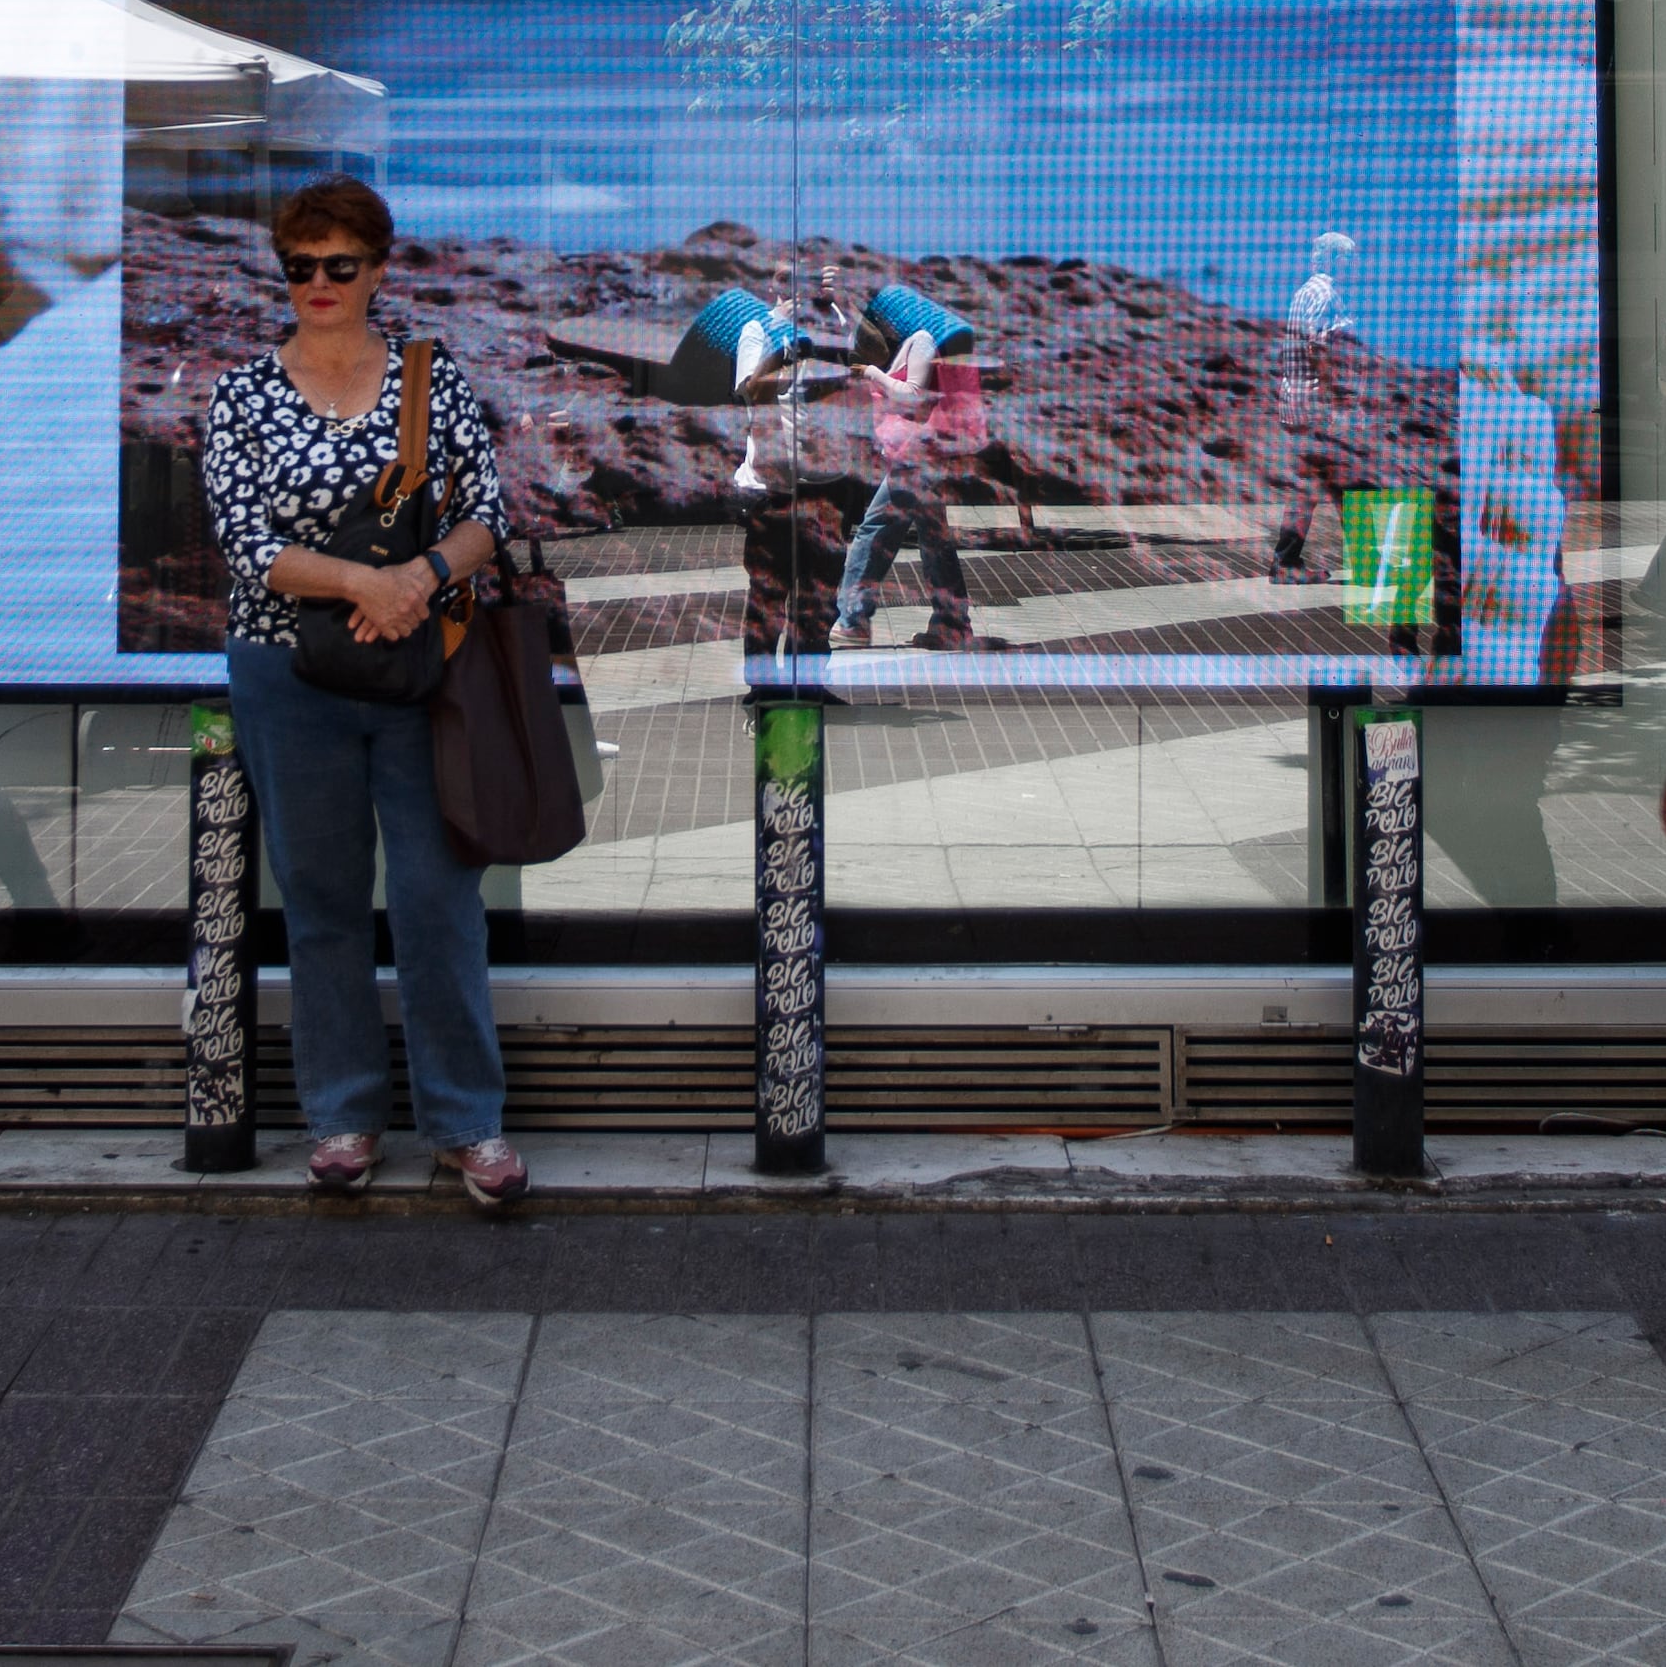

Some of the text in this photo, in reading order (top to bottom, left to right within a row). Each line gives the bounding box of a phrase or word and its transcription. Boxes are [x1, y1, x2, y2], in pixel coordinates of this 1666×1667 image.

[196, 792, 249, 824] POLO
[764, 803, 814, 834] POLO
[1365, 803, 1417, 834] POLO
[193, 854, 246, 884] POLO
[763, 861, 815, 893] POLO
[1366, 859, 1418, 891] POLO
[193, 911, 246, 944] POLO
[764, 921, 816, 953] POLO
[1364, 919, 1417, 951] POLO
[197, 972, 242, 1004] OLO
[765, 979, 817, 1014] POLO
[1367, 977, 1419, 1010] POLO
[192, 1026, 245, 1062] POLO
[765, 1042, 817, 1077] POLO
[767, 1101, 818, 1135] POLO
